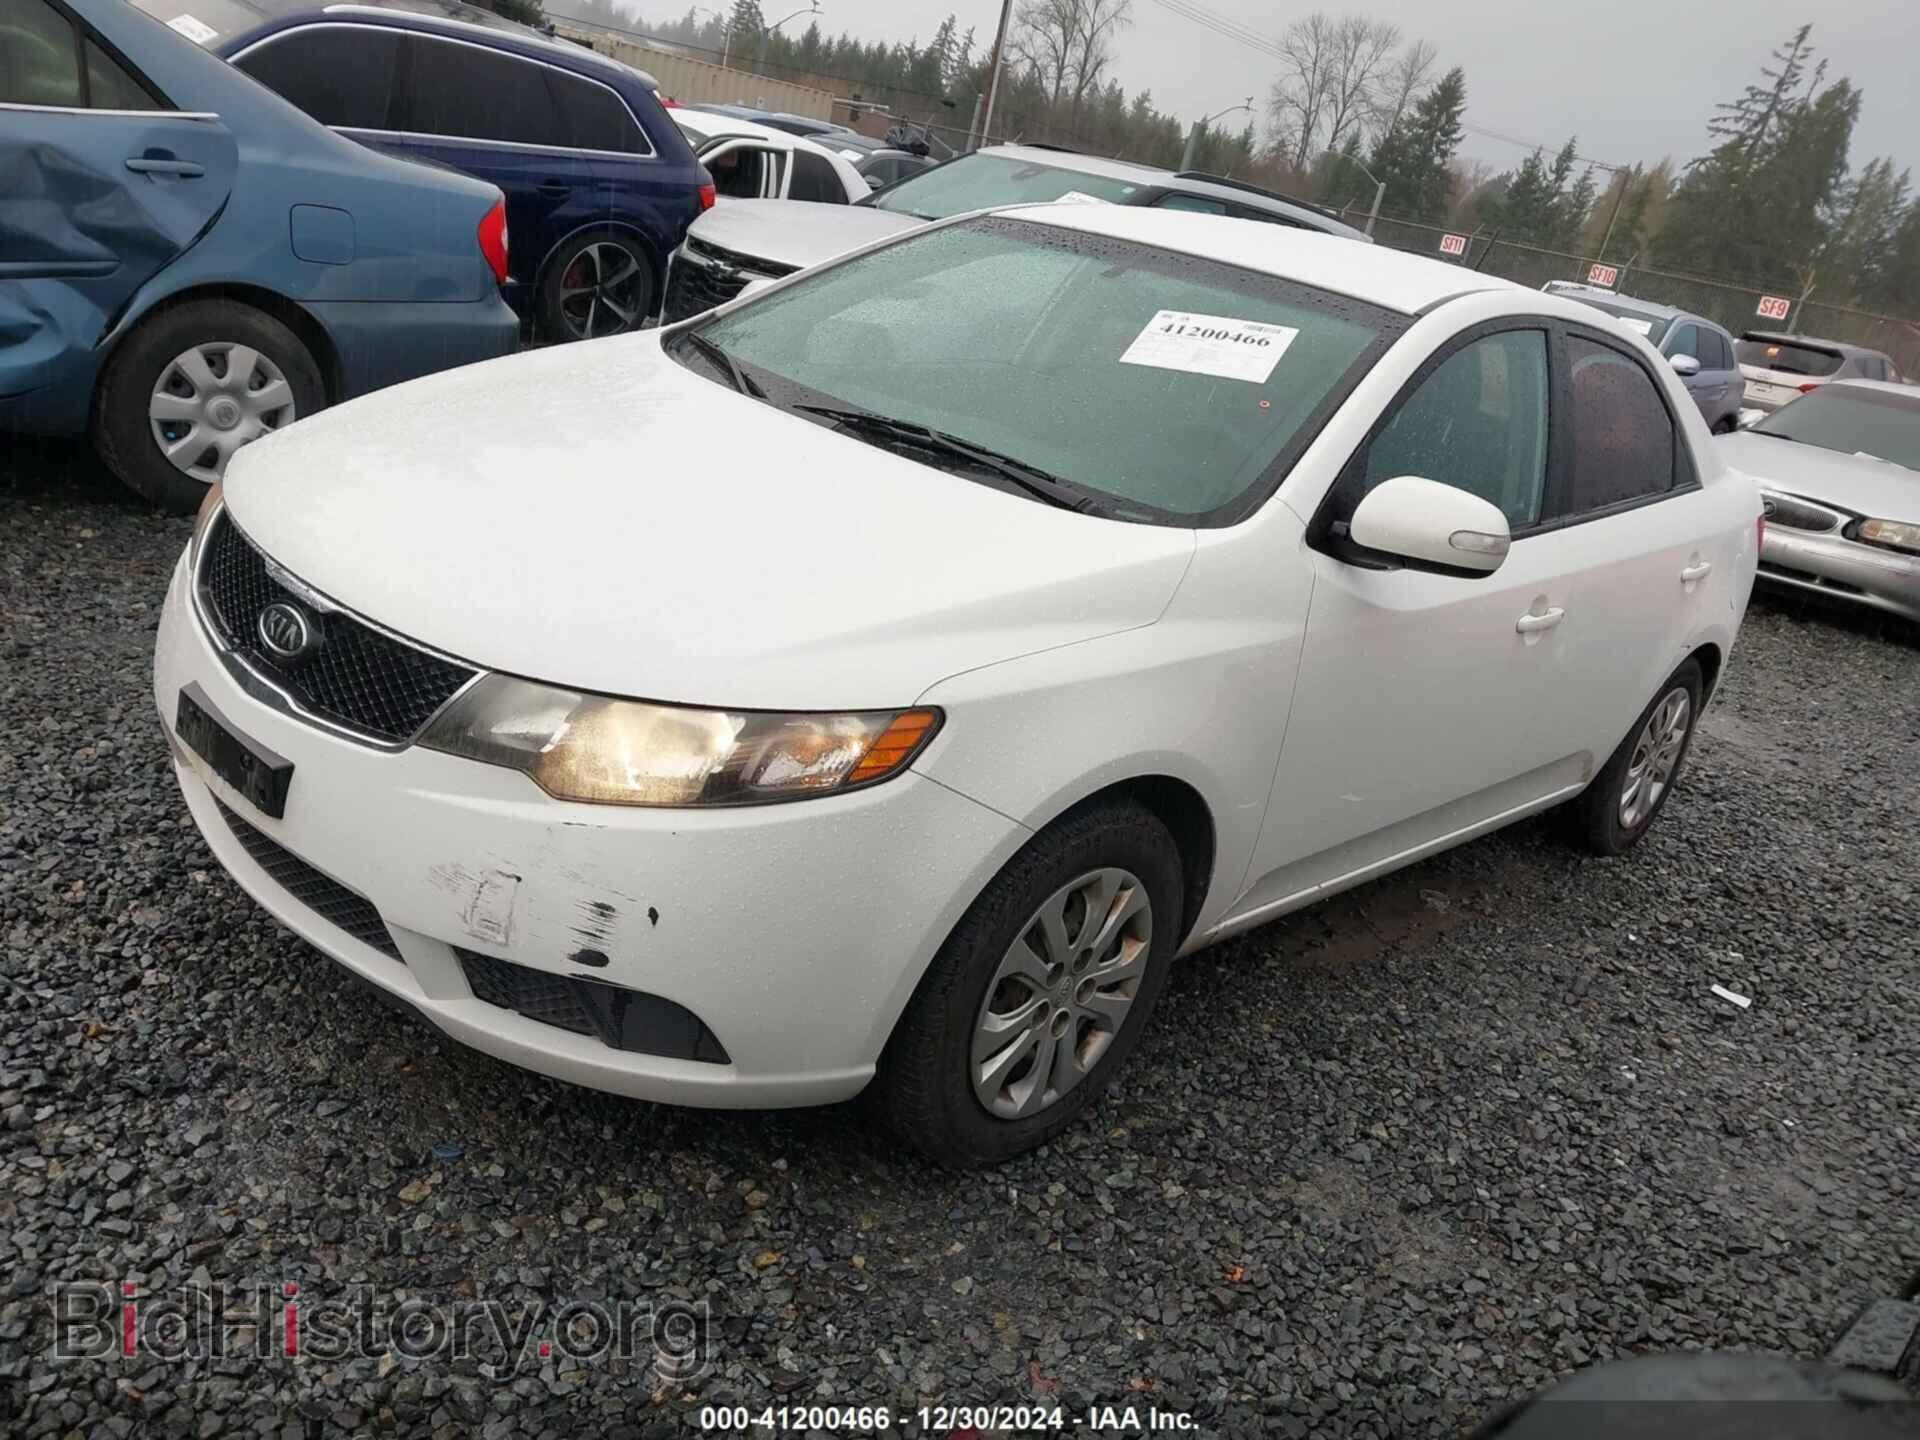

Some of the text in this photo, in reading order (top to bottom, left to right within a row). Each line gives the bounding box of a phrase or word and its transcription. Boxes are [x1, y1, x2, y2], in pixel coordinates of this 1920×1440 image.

[1590, 266, 1615, 284] SF10
[1760, 299, 1787, 316] SF9
[1160, 323, 1270, 347] 41200466
[265, 609, 300, 650] KIA
